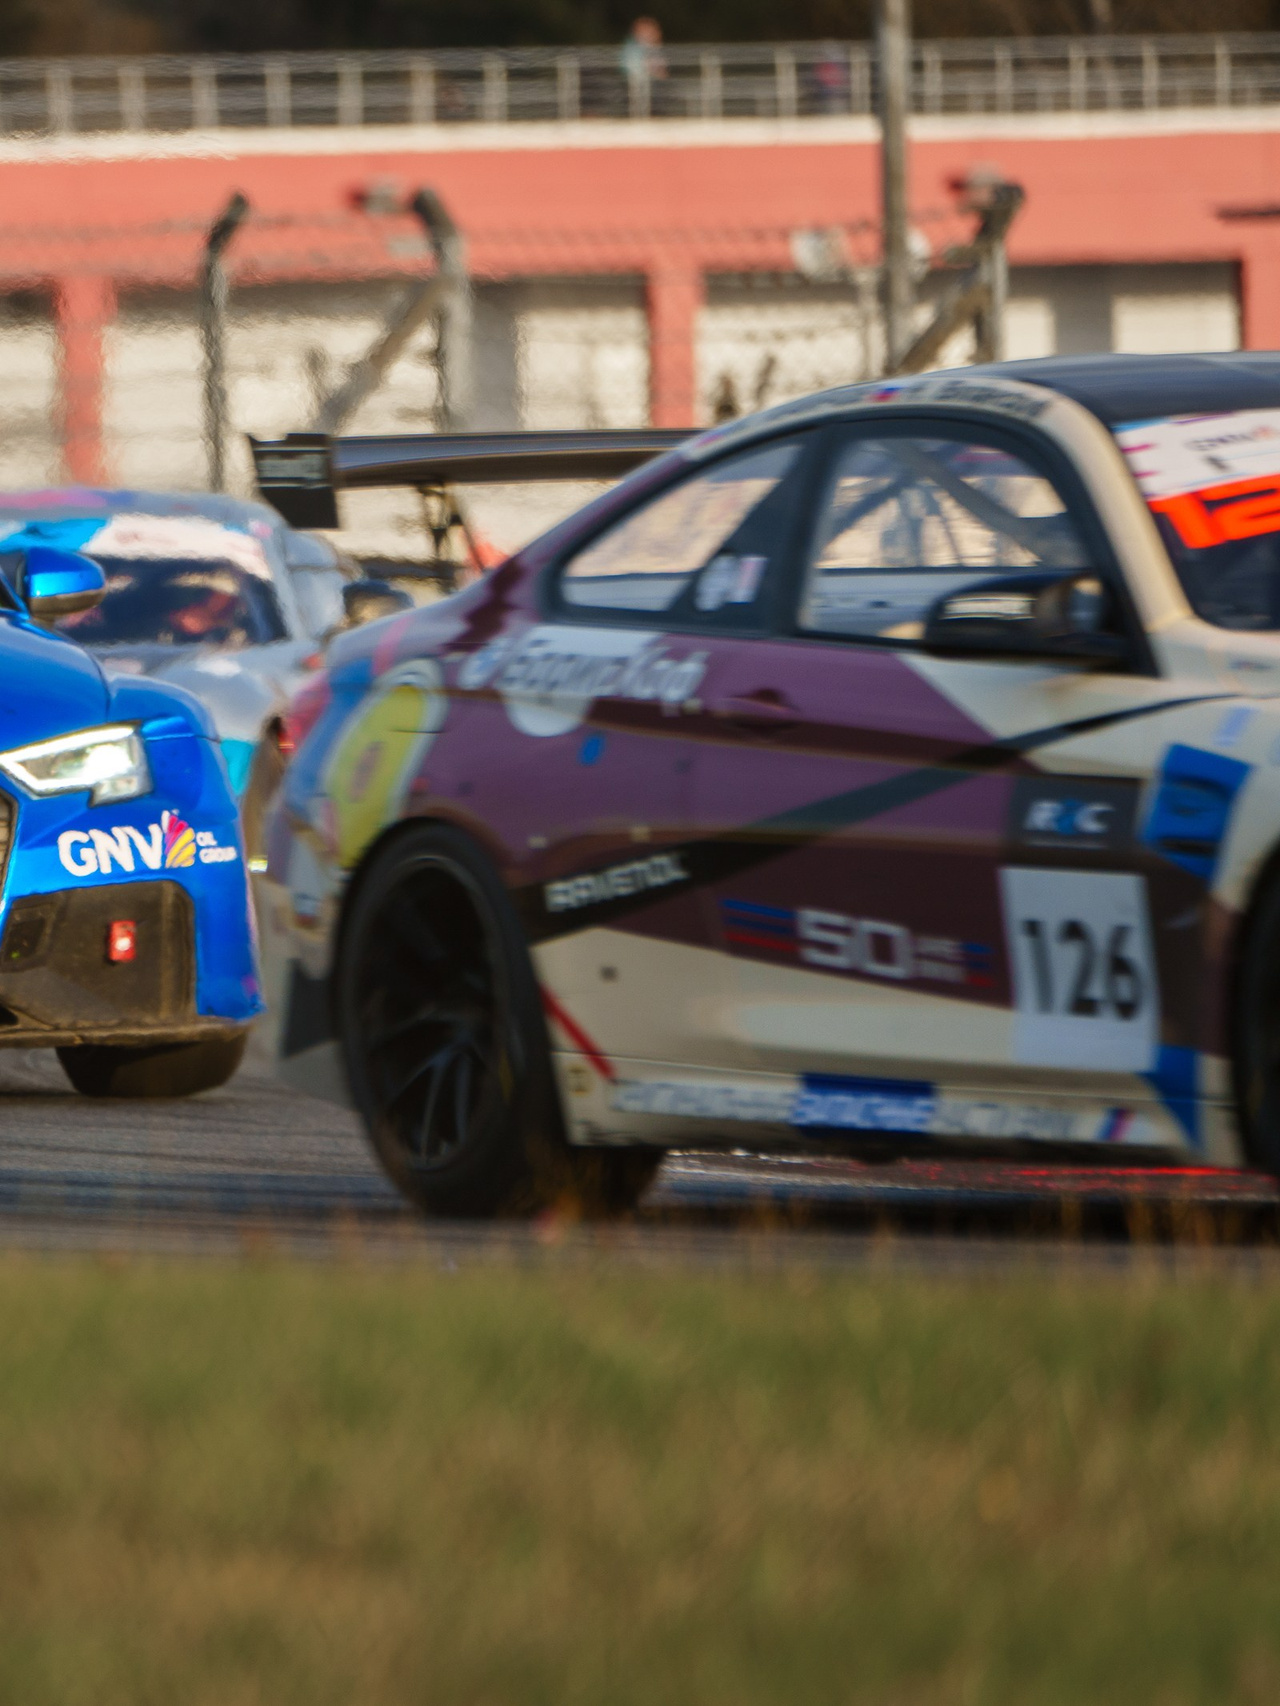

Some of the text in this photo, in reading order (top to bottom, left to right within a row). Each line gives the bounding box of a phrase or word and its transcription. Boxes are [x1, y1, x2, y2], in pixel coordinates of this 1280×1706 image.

[57, 822, 164, 878] GNV
[796, 907, 917, 980] 50
[1020, 917, 1144, 1022] 126
